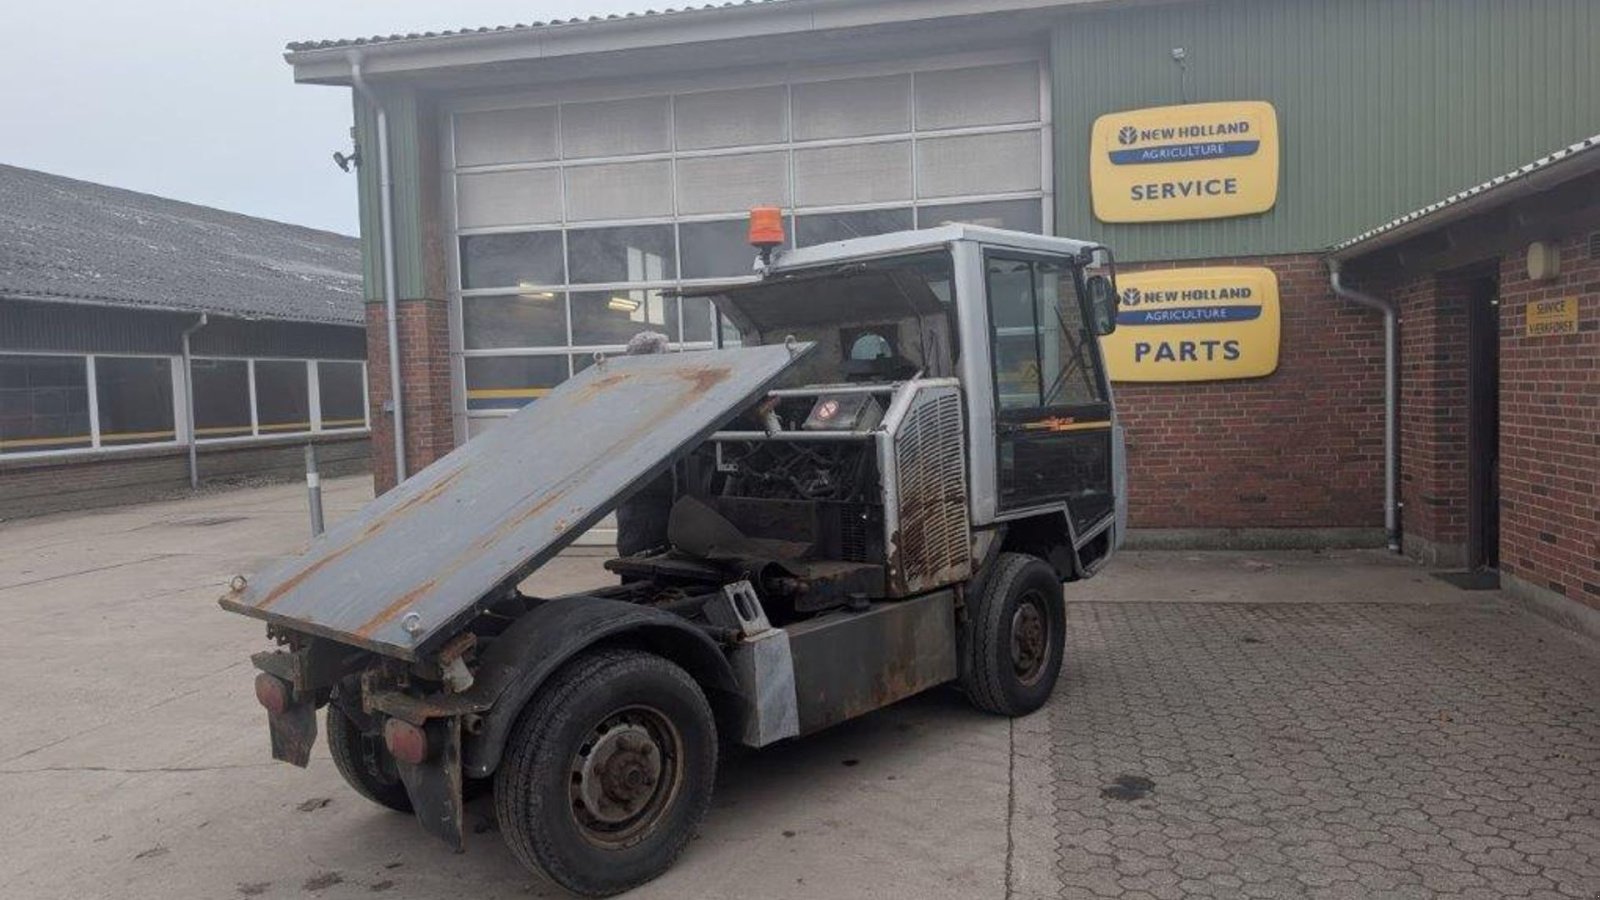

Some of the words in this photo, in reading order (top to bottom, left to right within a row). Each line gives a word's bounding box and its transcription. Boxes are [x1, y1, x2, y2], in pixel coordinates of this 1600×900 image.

[1141, 128, 1174, 141] NEW
[1179, 121, 1250, 137] HOLLAND
[1142, 143, 1225, 160] AGRICULTURE
[1131, 177, 1237, 201] SERVICE
[1144, 290, 1178, 303] NEW
[1182, 287, 1252, 302] HOLLAND
[1145, 308, 1227, 322] AGRICULTURE
[1135, 340, 1241, 363] PARTS
